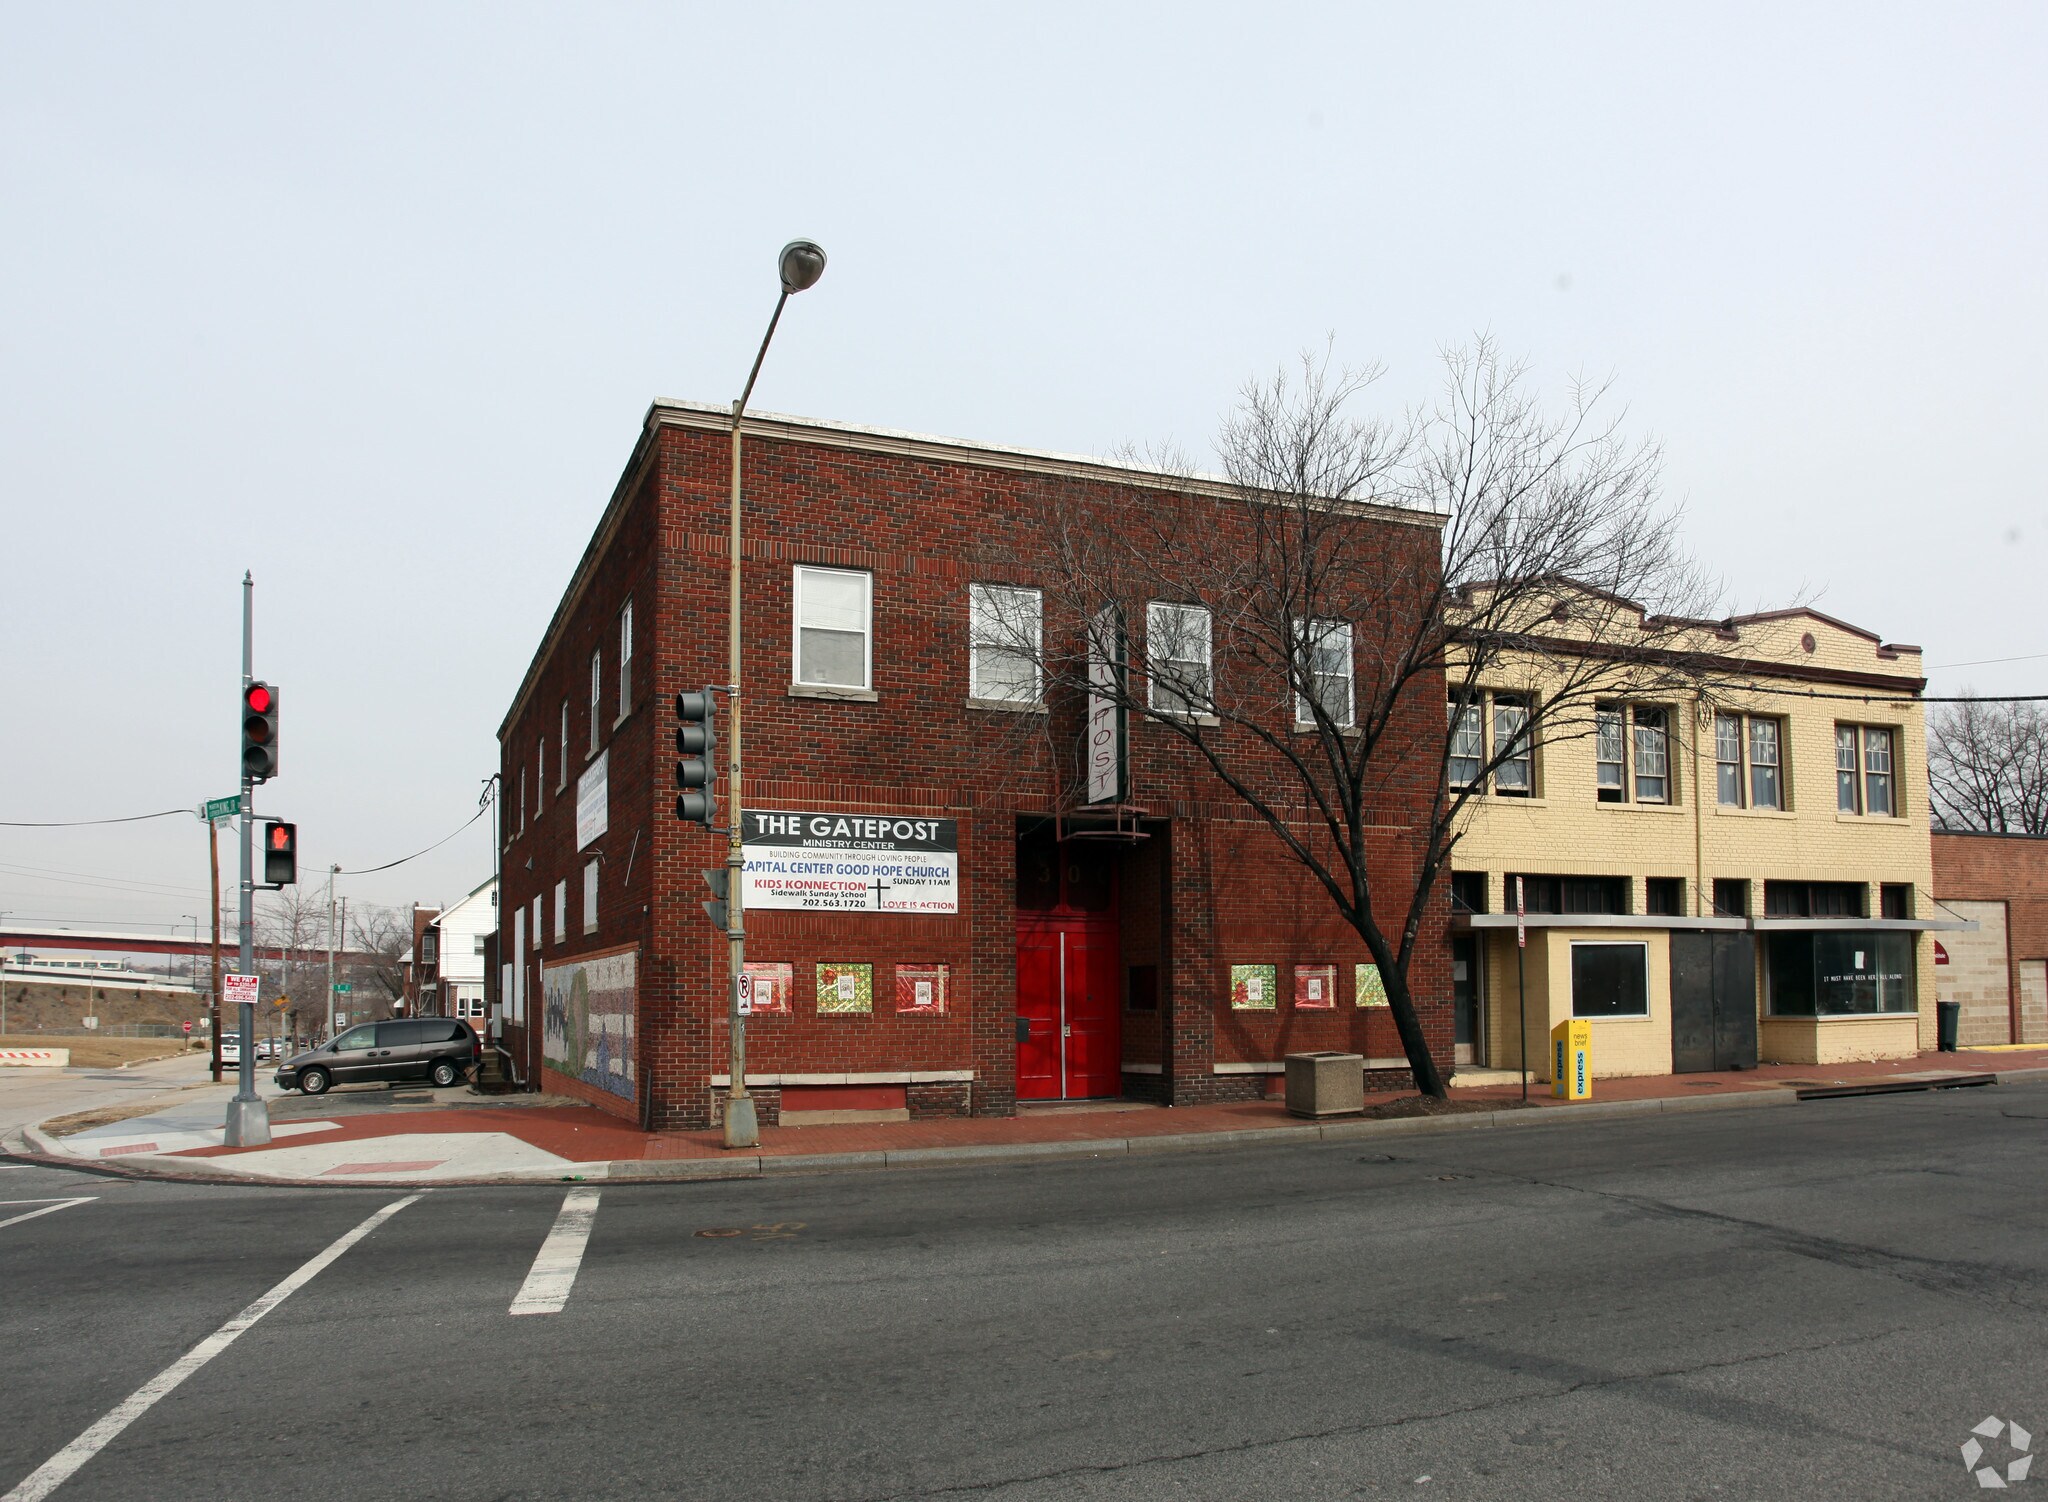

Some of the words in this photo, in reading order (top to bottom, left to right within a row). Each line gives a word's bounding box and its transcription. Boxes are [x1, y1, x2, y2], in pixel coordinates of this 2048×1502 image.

[755, 814, 801, 836] THE
[809, 817, 940, 841] GATEPOST
[802, 838, 851, 848] MINISTRY
[853, 840, 895, 850] CENTER
[769, 850, 801, 859] BUILDING
[801, 851, 843, 860] COMMUNITY
[844, 852, 876, 861] THROUGH
[877, 854, 903, 862] LOVING
[904, 855, 927, 863] PEOPLE
[790, 862, 834, 875] CENTER
[836, 863, 870, 876] GOOD
[872, 865, 903, 877] HOPE
[905, 866, 950, 878] CHURCH
[754, 879, 782, 889] KIDS
[785, 880, 867, 891] KONNECTION
[892, 877, 926, 885] SUNDAY
[928, 878, 951, 886] 11AM
[770, 889, 808, 897] Sidewalk
[809, 890, 839, 899] Sunday
[802, 899, 866, 908] 202.563.1720
[882, 900, 908, 909] LOVE
[909, 901, 918, 909] IS
[919, 902, 955, 910] ACTION
